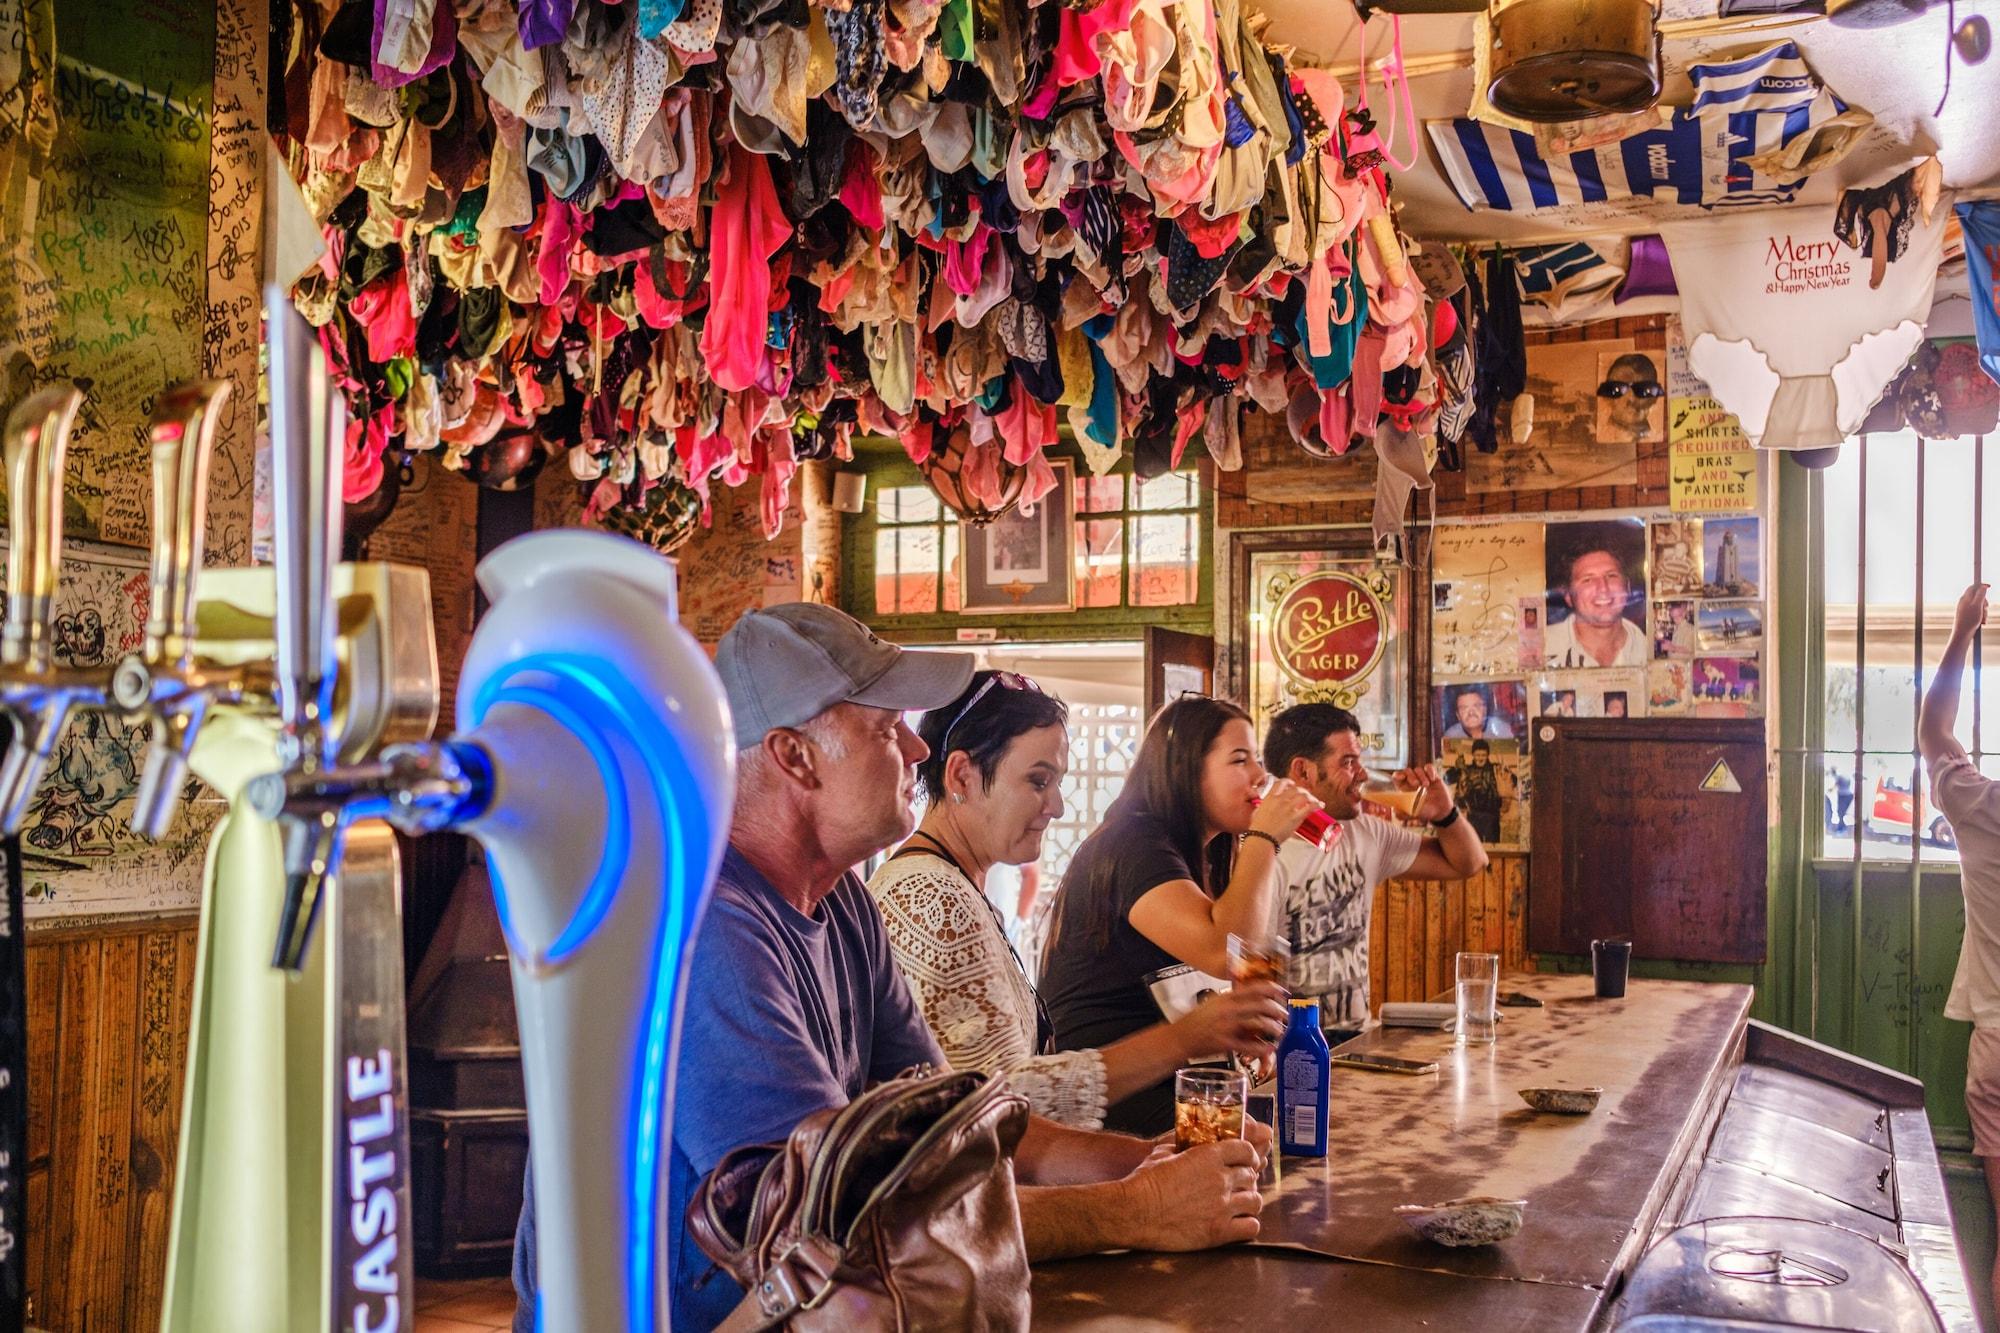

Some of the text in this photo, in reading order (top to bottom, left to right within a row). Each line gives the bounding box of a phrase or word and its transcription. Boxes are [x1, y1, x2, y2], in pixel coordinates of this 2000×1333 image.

[1765, 235, 1840, 266] Merry
[1775, 261, 1851, 282] Christmas
[1829, 276, 1850, 289] Year
[1688, 399, 1726, 411] SHO
[1699, 412, 1727, 425] AND
[1686, 426, 1740, 438] SHIRTS
[1676, 440, 1750, 453] REQUIRED
[1696, 456, 1732, 467] BRAS
[1702, 470, 1727, 480] AND
[1684, 483, 1745, 495] PANTIES
[1680, 497, 1748, 510] OPTIONAL
[1281, 590, 1374, 659] Castle
[1295, 653, 1360, 671] LAGER
[1291, 942, 1369, 988] JEANS
[347, 1048, 400, 1333] CASTLE
